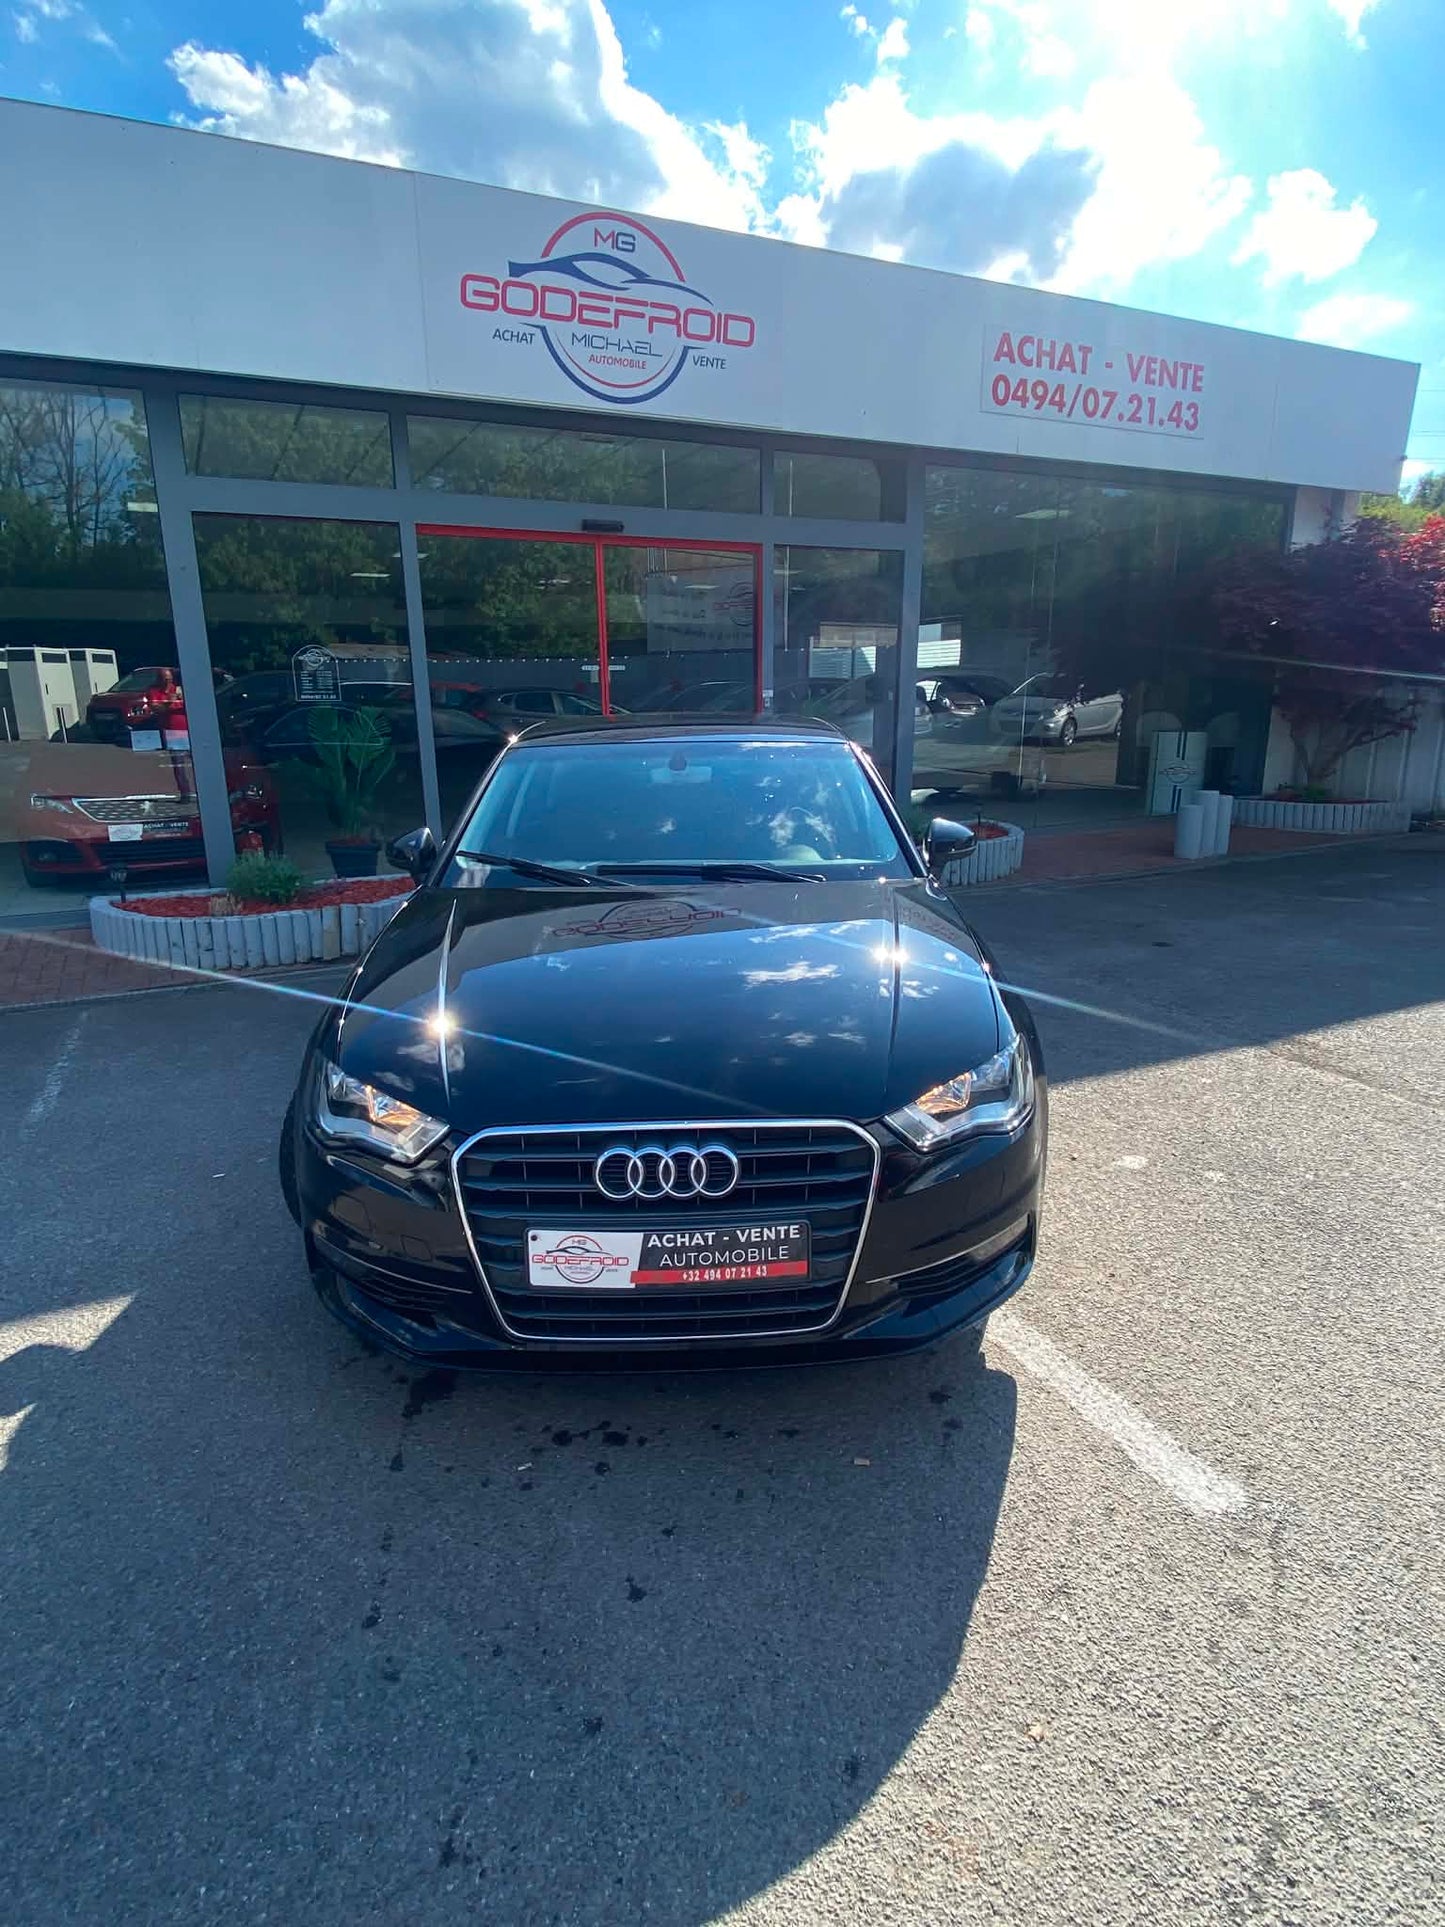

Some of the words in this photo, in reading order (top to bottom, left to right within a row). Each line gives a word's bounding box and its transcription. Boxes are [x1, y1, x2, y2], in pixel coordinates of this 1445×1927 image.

[594, 227, 636, 253] MG
[460, 273, 756, 348] GODEFROID
[492, 328, 535, 345] ACHAT
[692, 355, 726, 370] VENTE
[571, 332, 663, 358] MICHAEL
[588, 354, 647, 370] AUTOMOBILE
[993, 332, 1093, 375] ACHAT
[1127, 353, 1204, 392] VENTE
[991, 373, 1199, 431] 0494/07.21.43
[648, 1231, 716, 1248] ACHAT
[736, 1225, 800, 1243] VENTE
[532, 1255, 630, 1267] GODEFROID
[659, 1245, 789, 1267] AUTOMOBILE
[682, 1270, 700, 1281] +32
[703, 1269, 721, 1281] 494
[725, 1267, 736, 1279] 07
[741, 1266, 751, 1278] 21
[756, 1265, 768, 1277] 43
